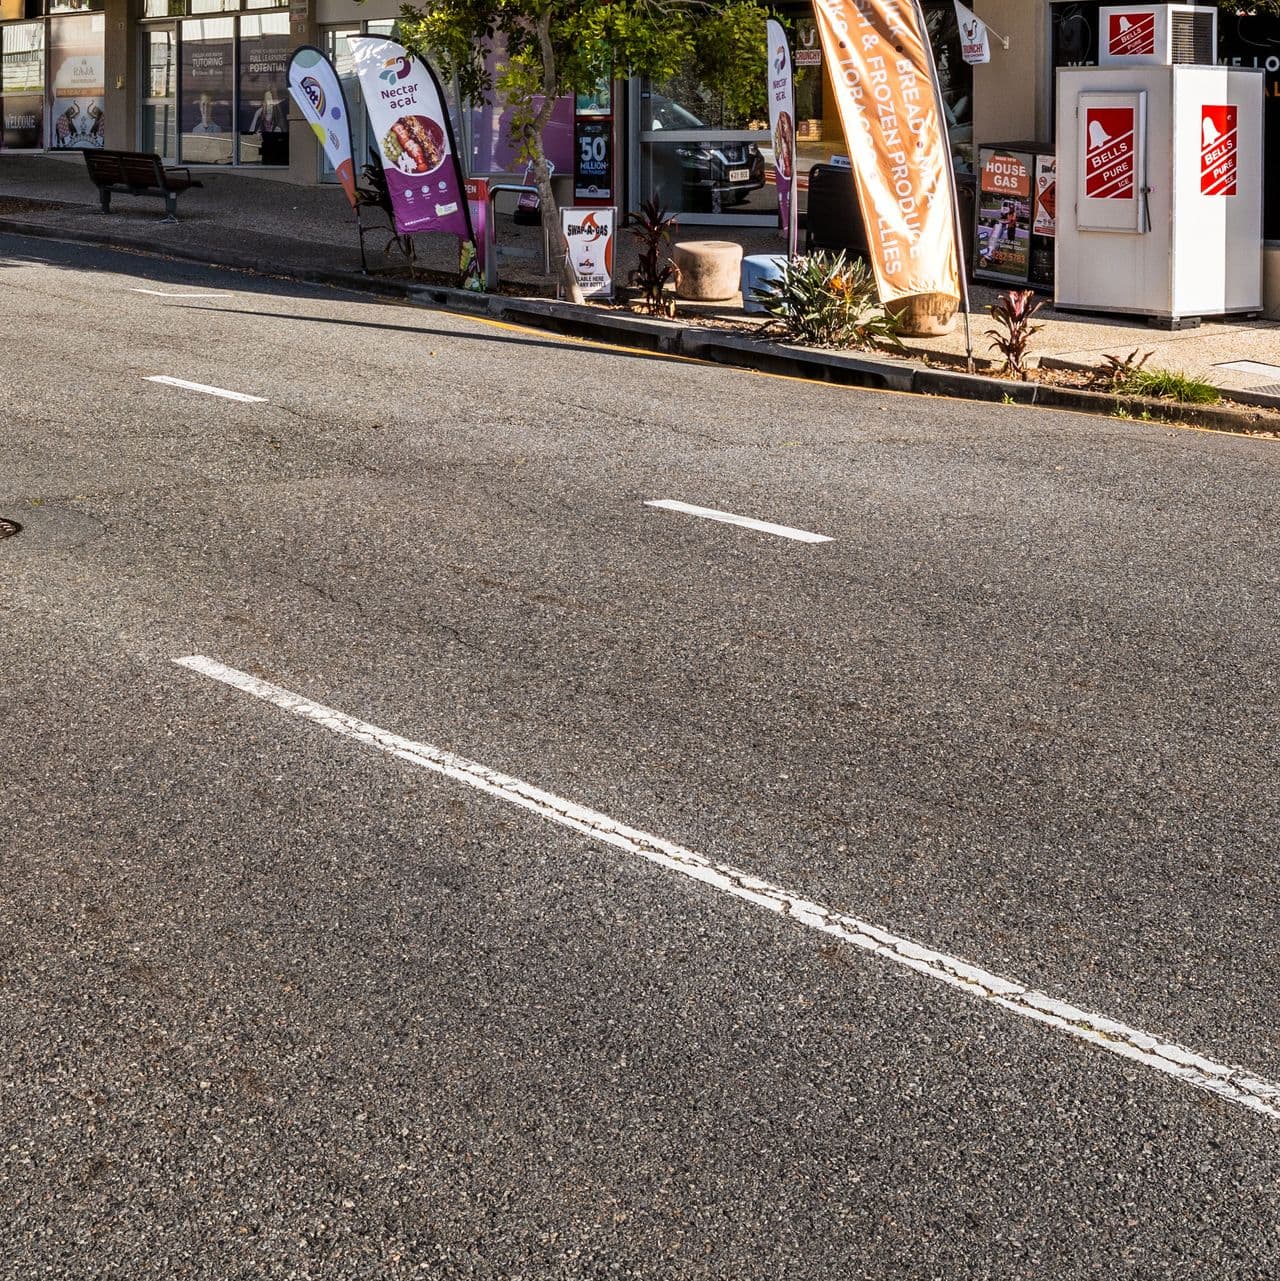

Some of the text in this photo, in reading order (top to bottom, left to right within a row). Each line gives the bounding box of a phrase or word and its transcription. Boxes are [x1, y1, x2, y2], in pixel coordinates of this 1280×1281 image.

[862, 34, 879, 51] &
[1121, 27, 1142, 43] BELLS
[192, 58, 223, 68] TUTORING
[249, 63, 287, 72] POTENTIAL
[73, 67, 95, 76] RAJA
[381, 83, 418, 100] Nectar
[896, 58, 925, 134] BREAD
[866, 55, 902, 147] FROZEN
[5, 115, 35, 129] WELCOME
[1091, 142, 1127, 168] BELLS
[1204, 140, 1233, 165] BELLS
[986, 161, 1026, 177] HOUSE
[1103, 162, 1129, 181] PURE
[1213, 159, 1233, 179] PURE
[464, 185, 477, 194] PEN
[994, 175, 1018, 188] GAS
[1118, 178, 1130, 188] ICE
[888, 151, 922, 258] PRODUCE
[567, 224, 608, 236] SWAP-A-GAS
